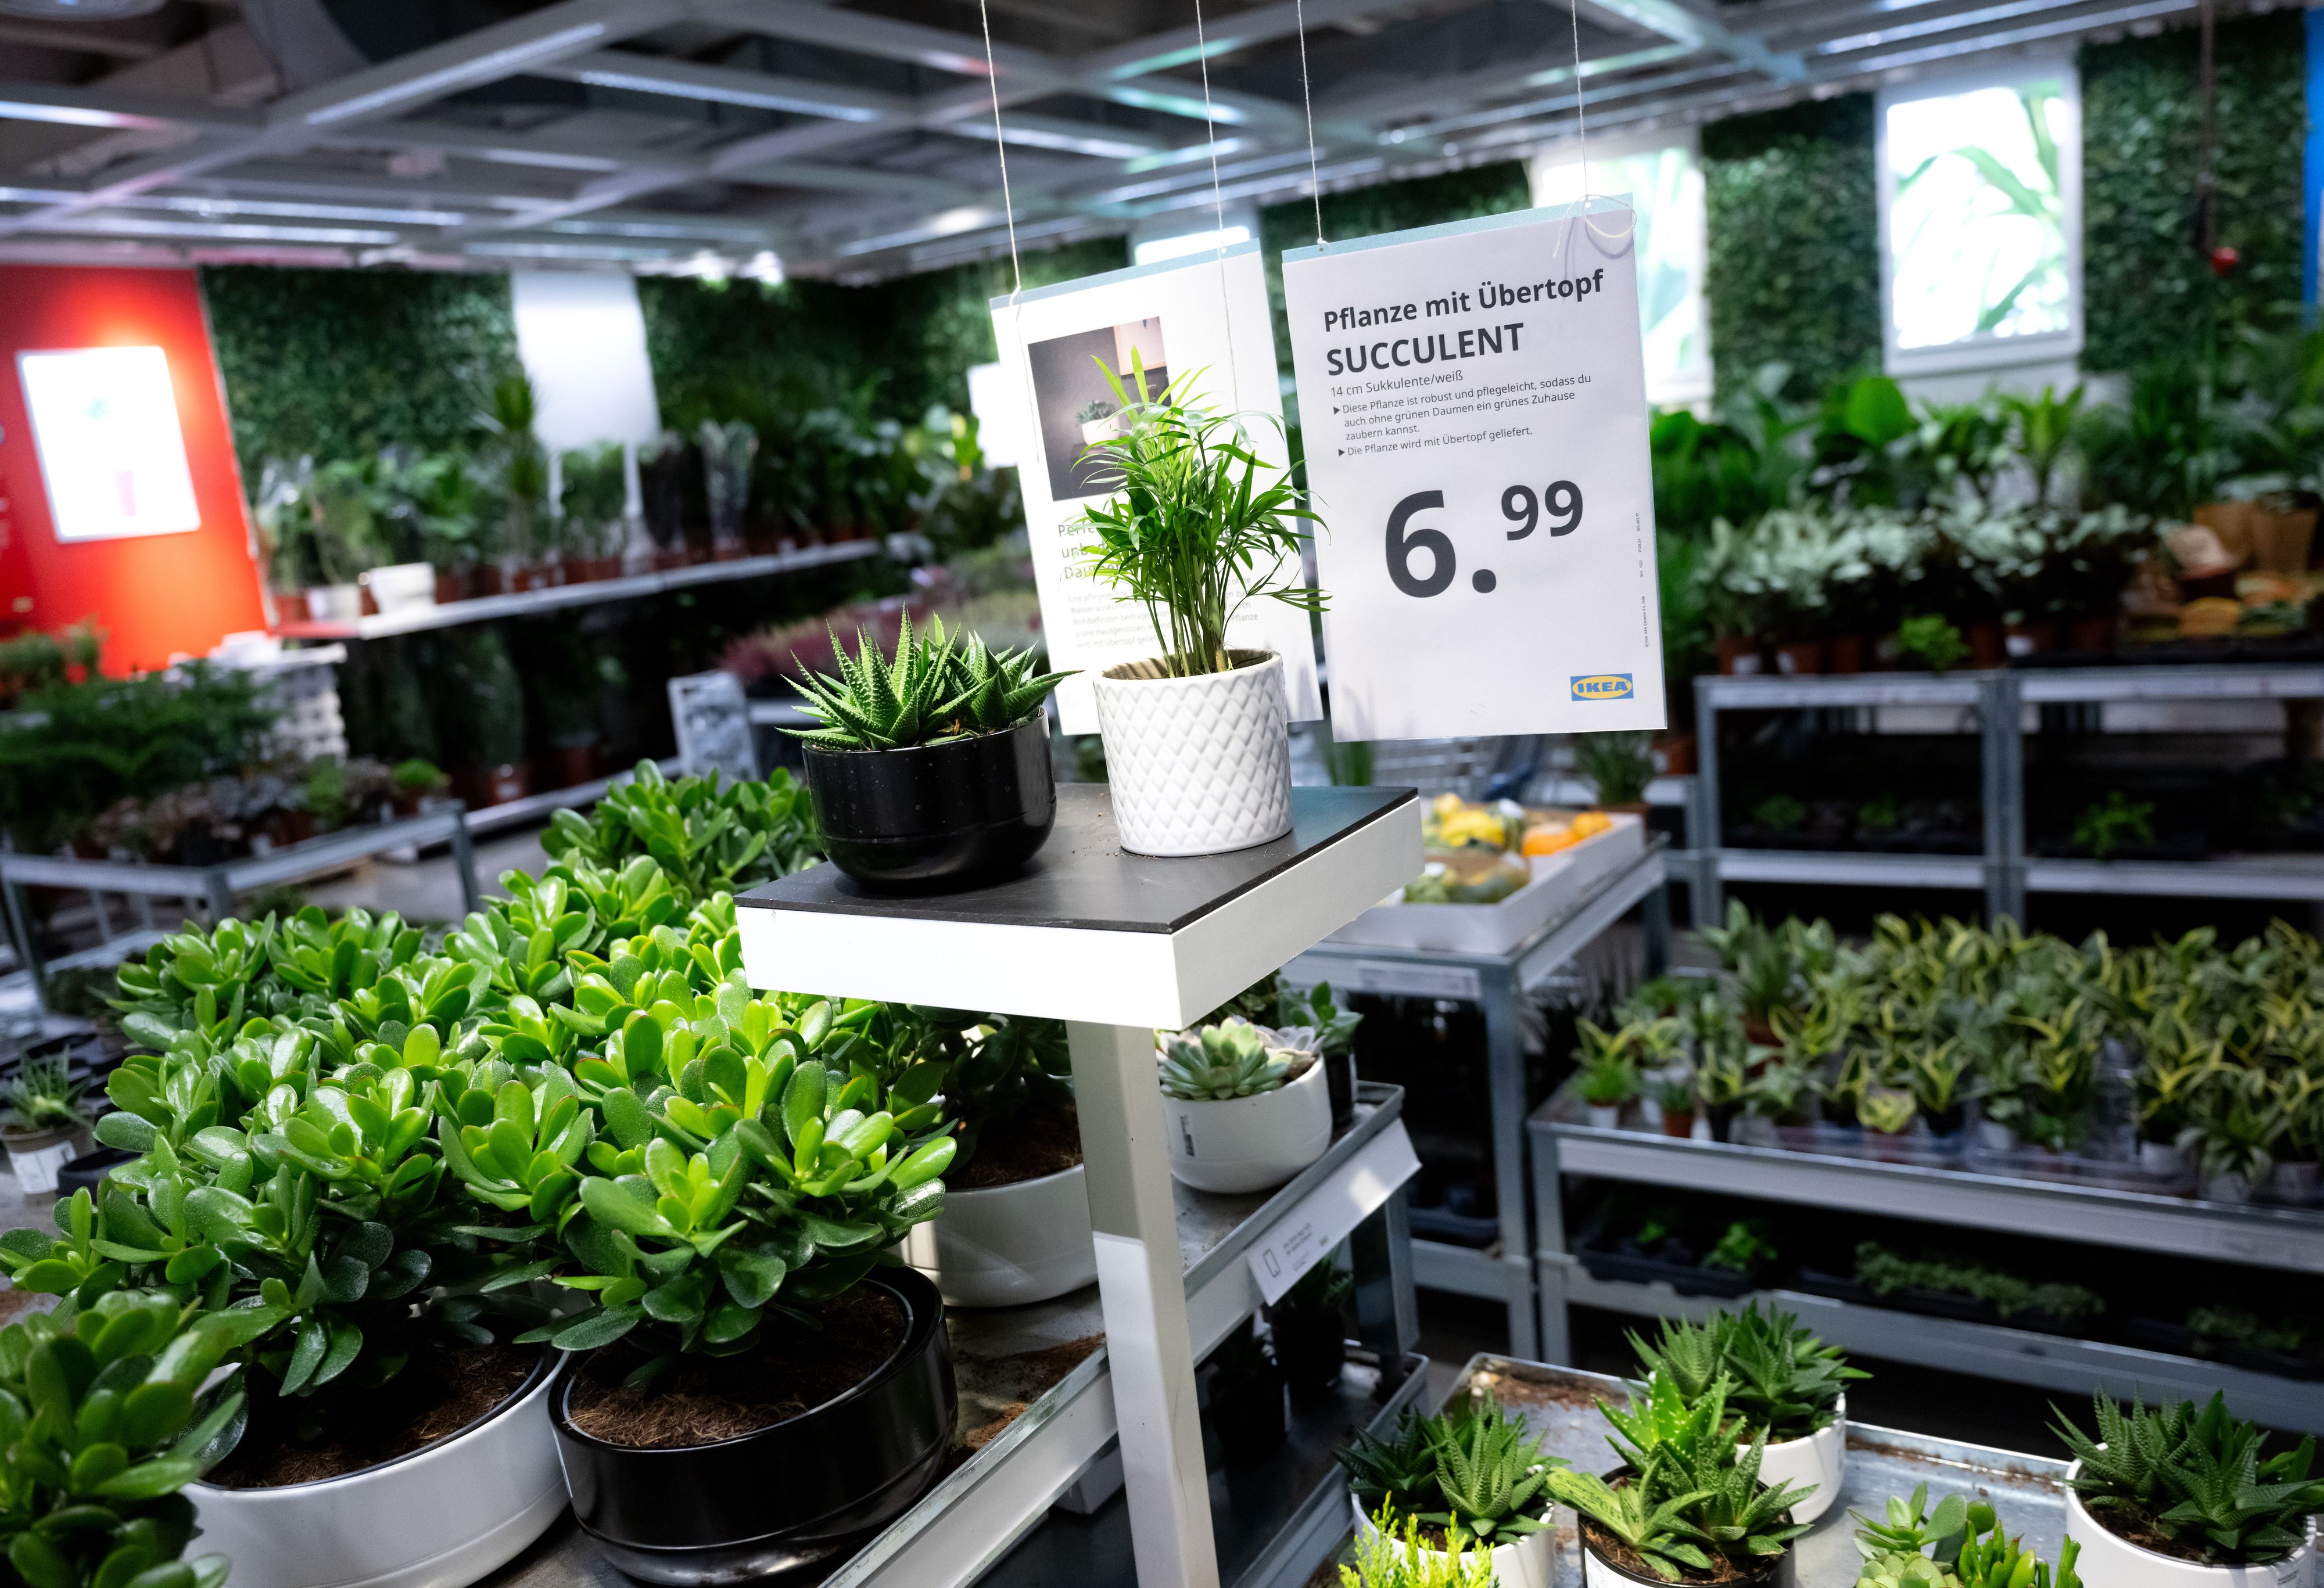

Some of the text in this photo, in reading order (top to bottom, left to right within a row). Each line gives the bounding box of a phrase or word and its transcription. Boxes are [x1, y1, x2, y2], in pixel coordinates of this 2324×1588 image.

[1324, 268, 1604, 333] Pflanze mit Übertopf
[1326, 322, 1525, 376] SUCCULENT
[1330, 369, 1464, 397] 14 cm Sukkulente/weiß
[1342, 373, 1591, 415] Diese Pflanze ist robust und pflegeleicht, sodass du
[1344, 392, 1575, 427] auch ohne grünen Daumen ein grünes Zuhause
[1345, 425, 1420, 441] zaubern kannst.
[1347, 427, 1533, 456] Die Pflanze wird mit Übertopf geliefert.
[1231, 613, 1258, 623] Pflanze
[1577, 680, 1629, 694] IKEA
